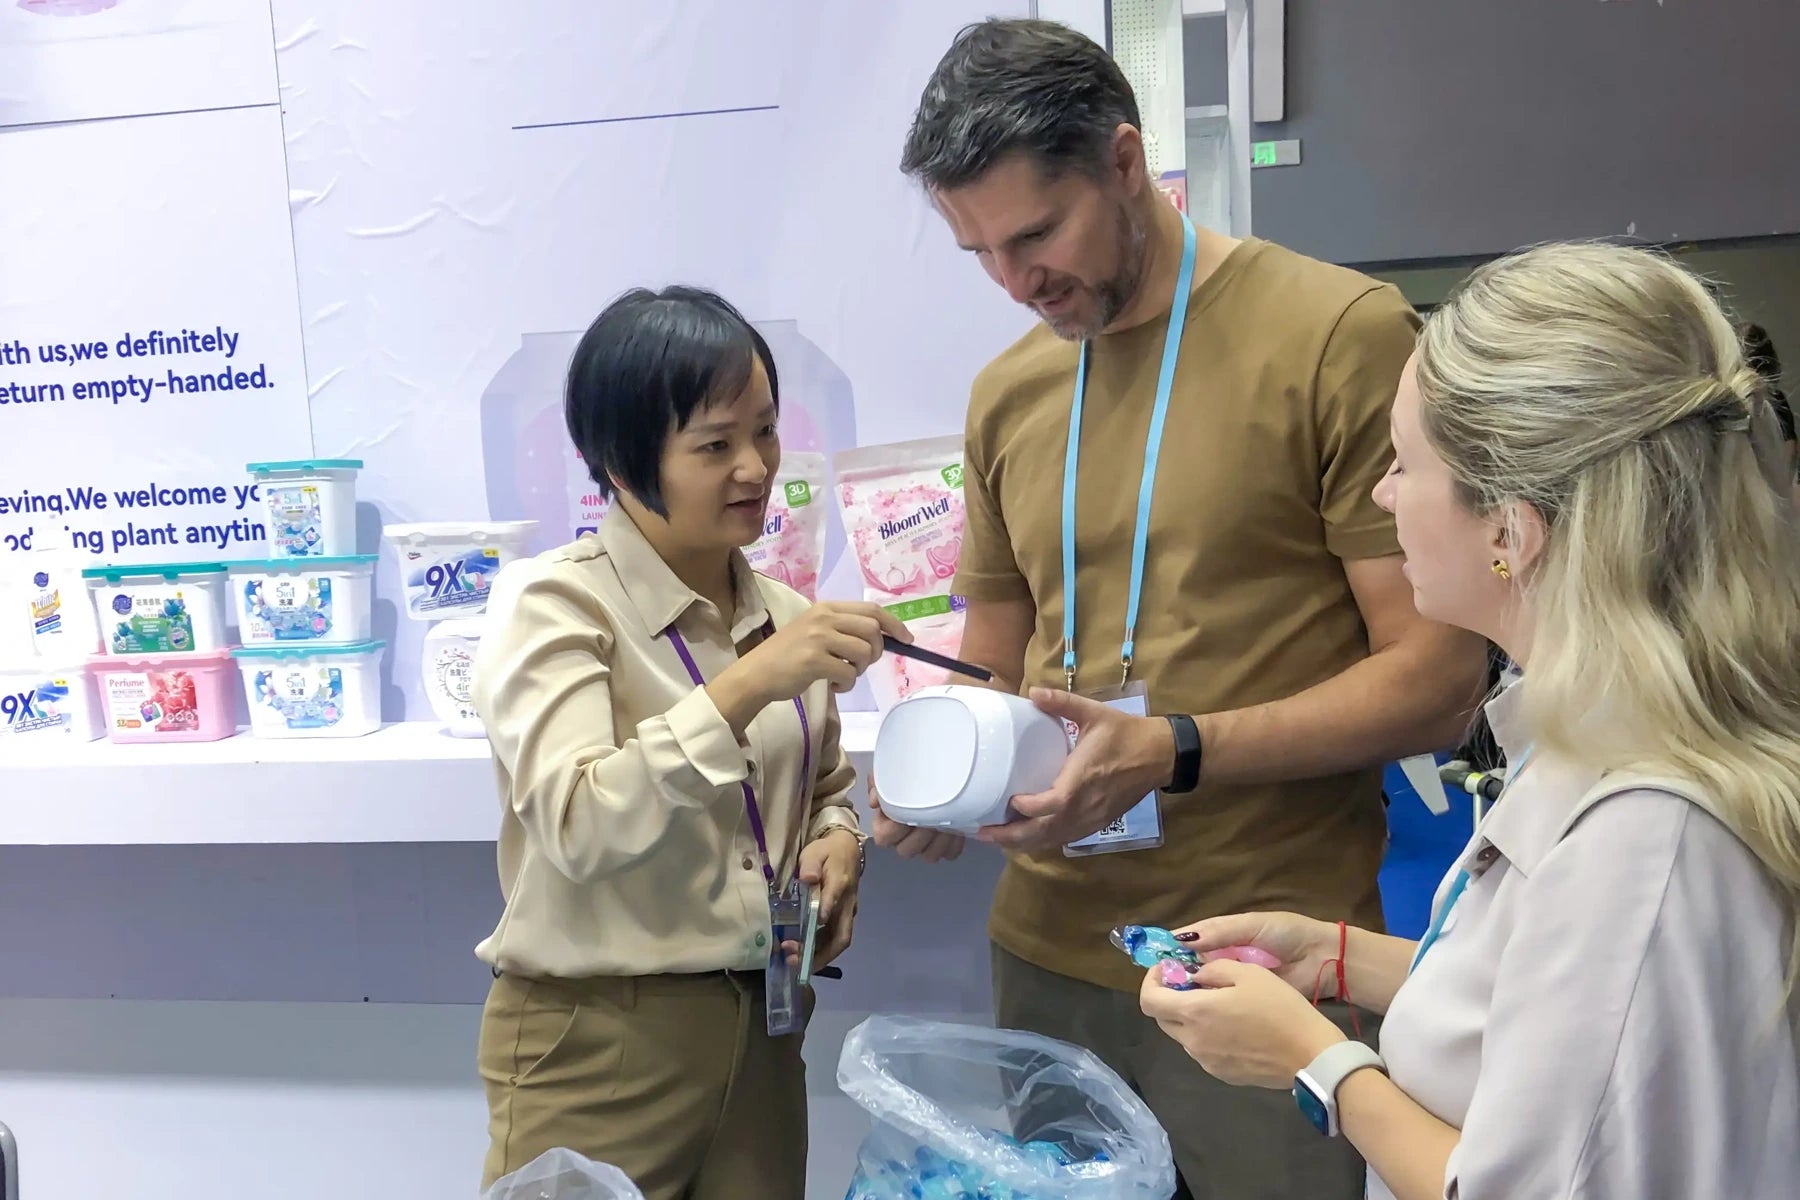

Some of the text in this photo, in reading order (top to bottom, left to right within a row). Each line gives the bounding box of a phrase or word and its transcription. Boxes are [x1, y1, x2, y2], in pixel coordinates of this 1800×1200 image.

[38, 341, 108, 366] us,we
[116, 326, 239, 358] definitely
[0, 363, 275, 404] eturn empty-handed.
[113, 482, 227, 508] welcome
[580, 494, 609, 506] 4IN
[788, 483, 806, 497] 3D
[582, 511, 606, 521] LAUN
[111, 522, 179, 554] plant
[425, 560, 464, 597] 9X
[109, 678, 145, 687] Perfume
[1, 689, 36, 725] 9X
